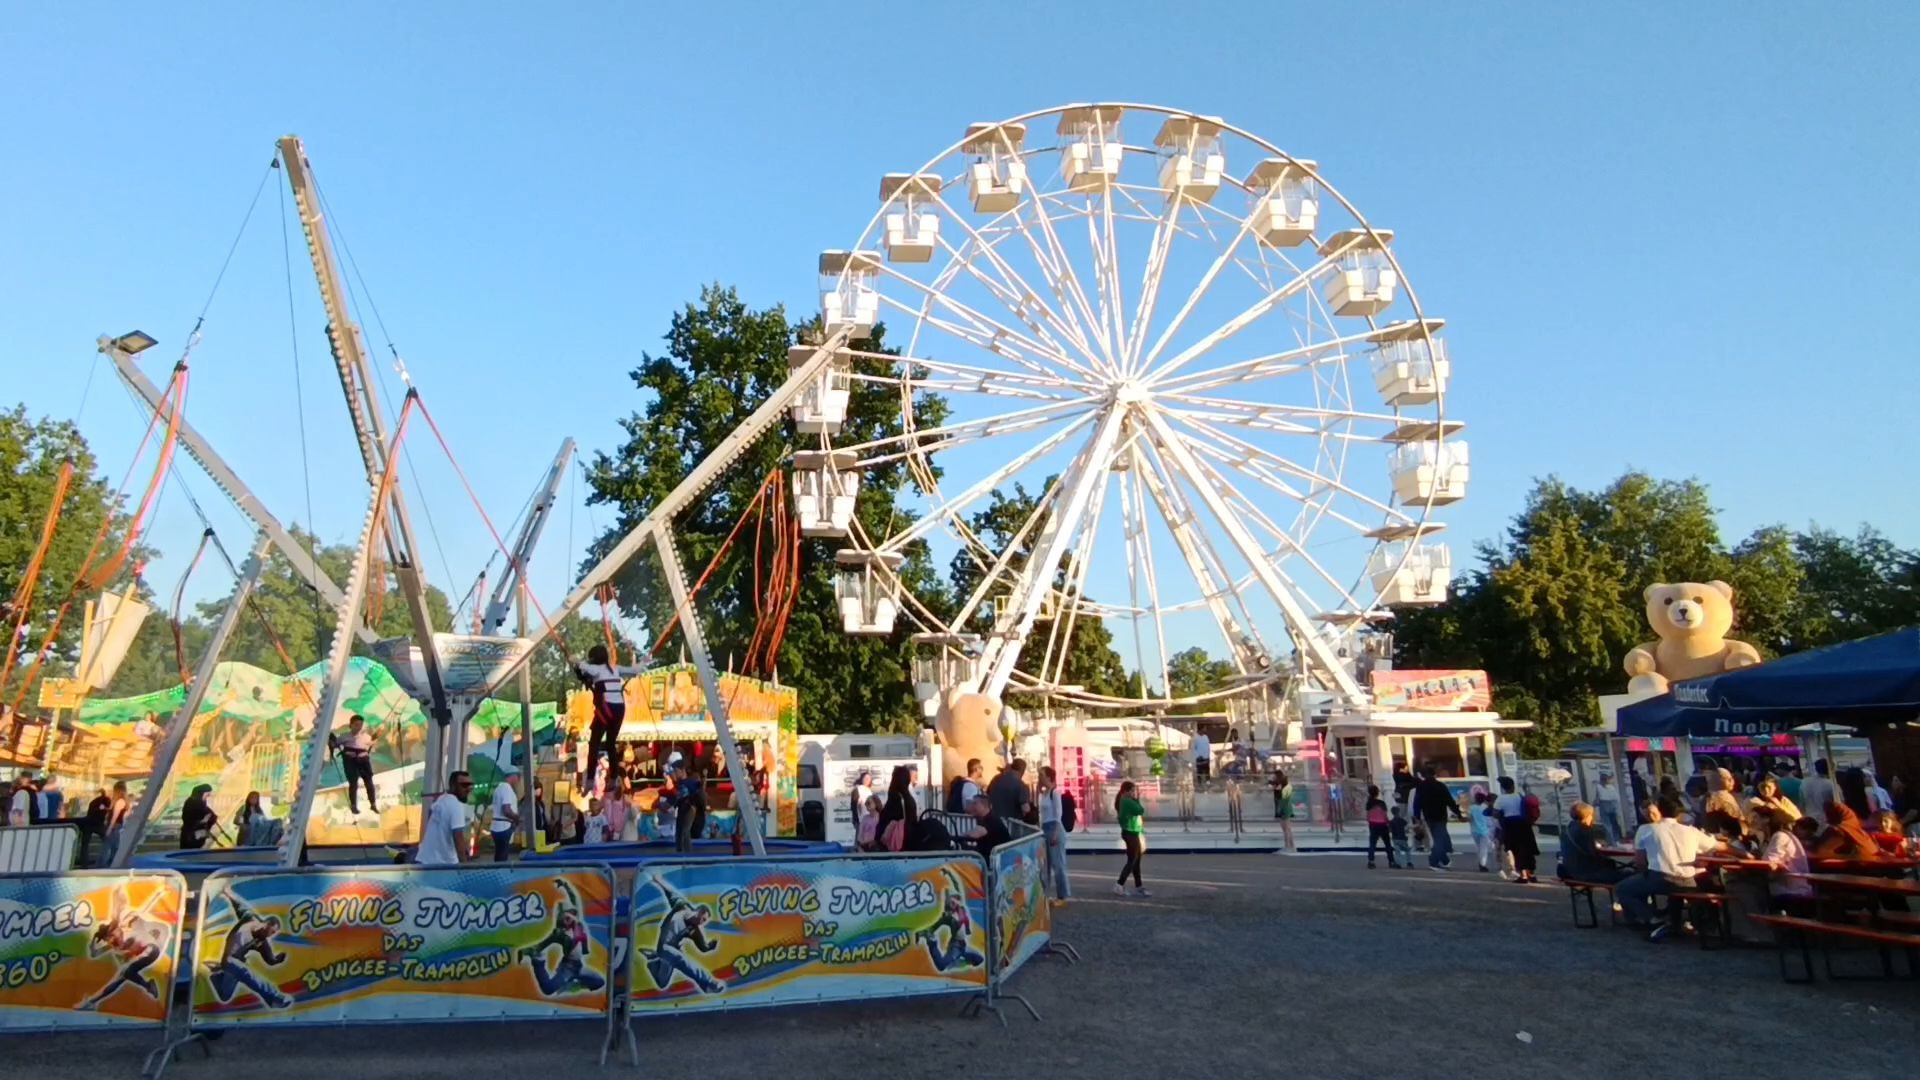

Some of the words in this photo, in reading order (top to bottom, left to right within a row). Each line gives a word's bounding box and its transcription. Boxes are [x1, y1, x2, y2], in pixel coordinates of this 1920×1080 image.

[0, 900, 93, 939] MPER
[290, 897, 404, 933] FLYING
[414, 892, 544, 930] JUMPER
[719, 886, 820, 921] FLYING
[828, 881, 934, 915] JUMPER
[384, 933, 424, 951] DAS
[803, 920, 838, 937] DAS
[302, 948, 511, 992] BUNGEE-TRAMPOLIN
[733, 931, 911, 976] BUNGEE-TRAMPOLIN
